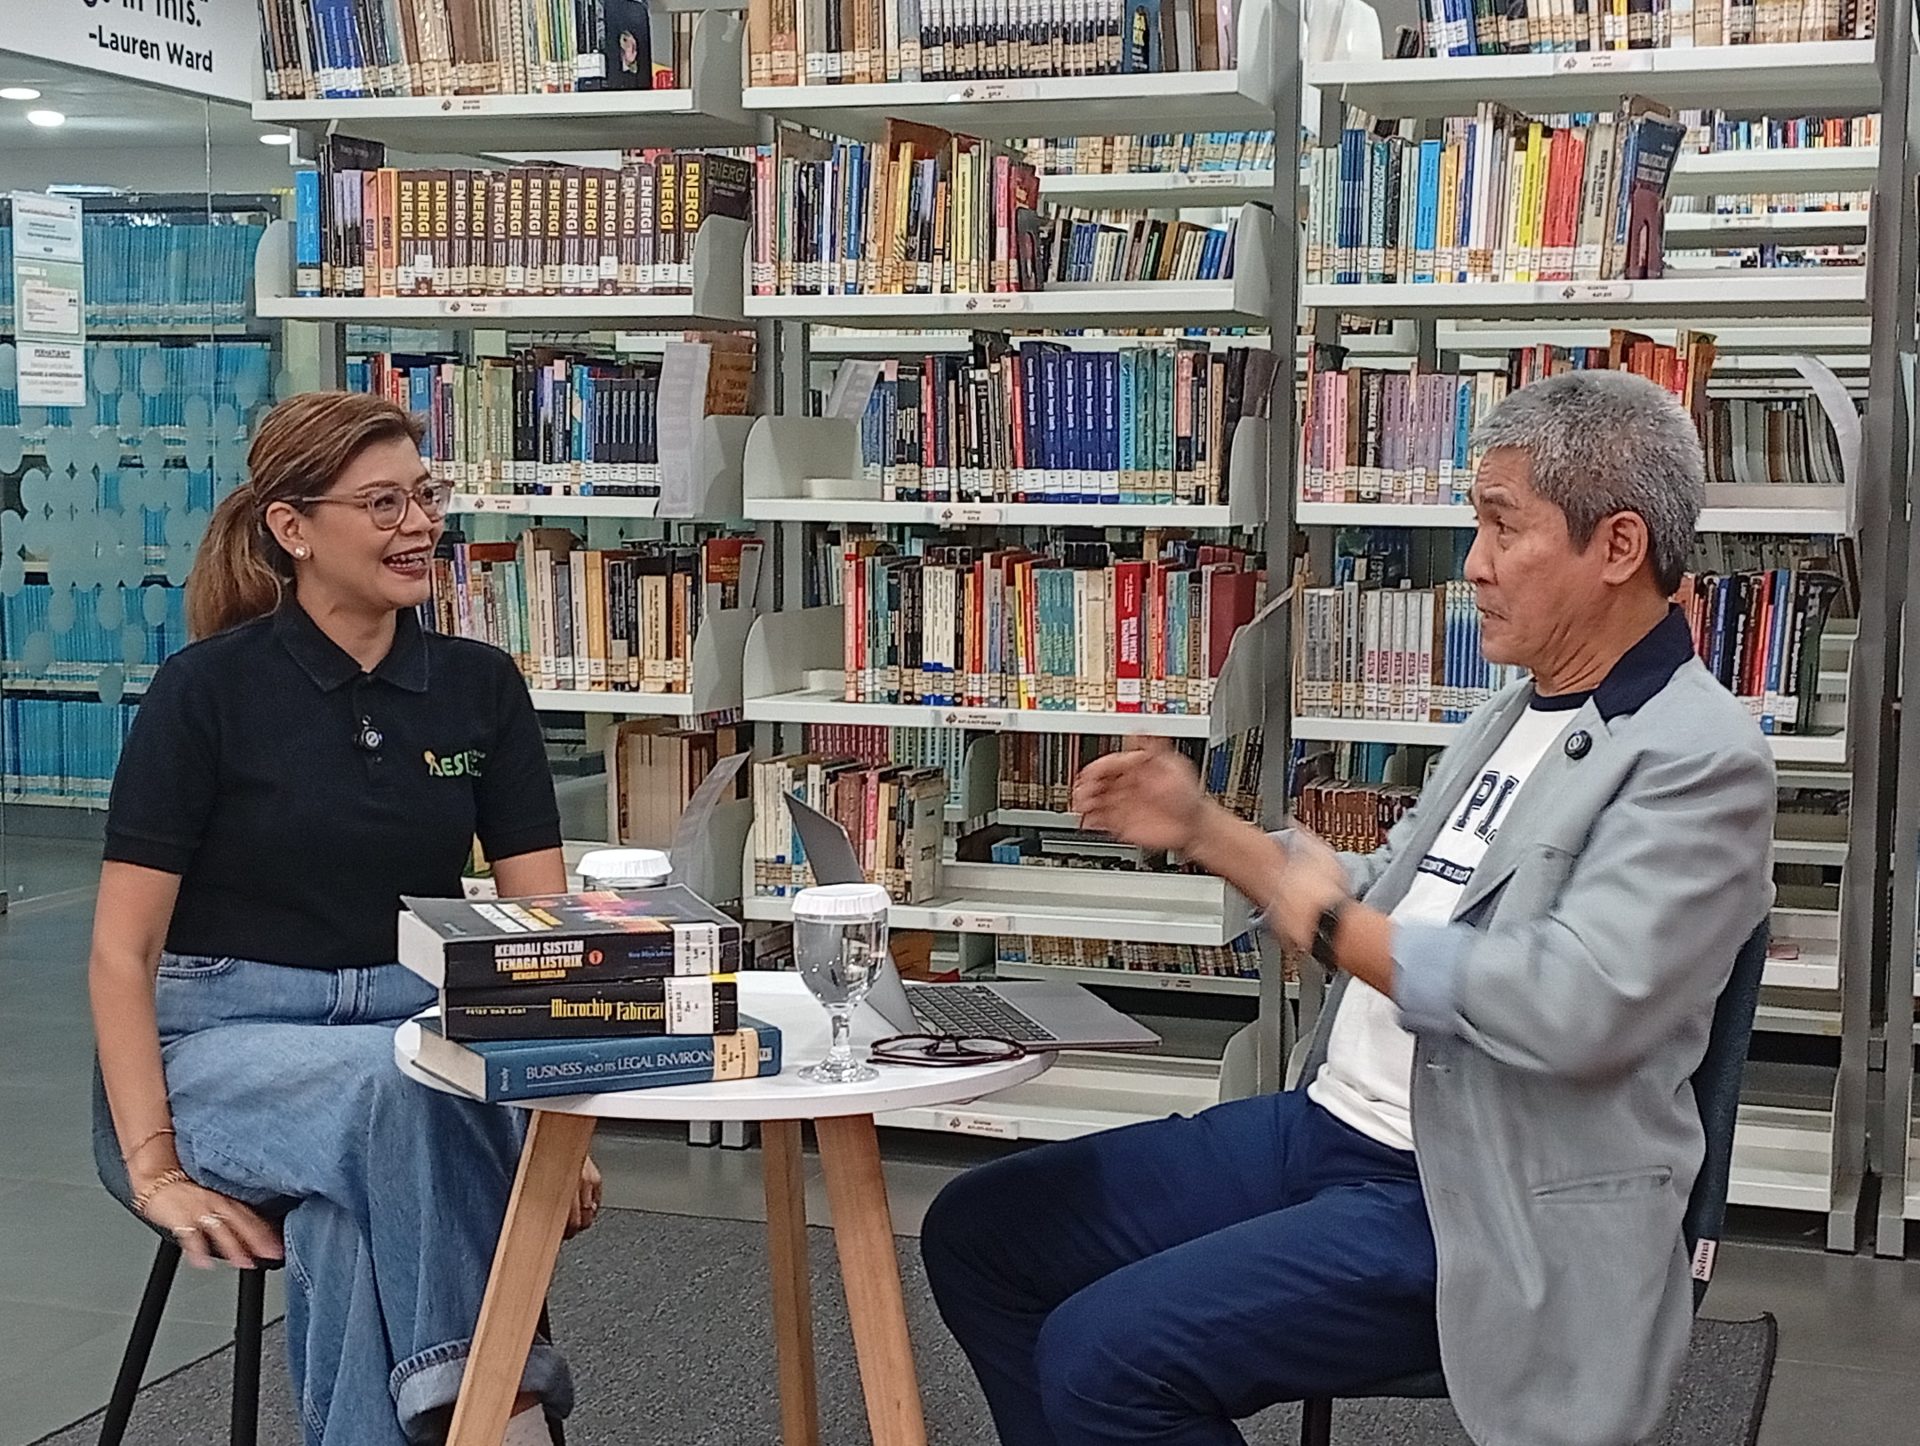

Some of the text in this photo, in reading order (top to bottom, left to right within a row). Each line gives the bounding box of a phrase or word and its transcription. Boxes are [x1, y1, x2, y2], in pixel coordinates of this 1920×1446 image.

[89, 25, 213, 73] -Lauren Ward
[401, 181, 414, 237] ENERGI
[418, 181, 430, 237] ENERGI
[436, 181, 447, 237] ENERGI
[454, 179, 466, 236] ENERGI
[472, 180, 486, 237] ENERGI
[492, 181, 506, 239] ENERGI
[510, 178, 522, 236] ENERGI
[529, 178, 542, 236] ENERGI
[548, 179, 561, 236] ENERGI
[566, 178, 578, 235] ENERGI
[584, 178, 598, 235] ENERGI
[604, 179, 616, 237] ENERGI
[624, 178, 635, 234] ENERGI
[640, 176, 652, 234] ENERGI
[660, 164, 675, 230] ENERGI
[684, 162, 700, 228] ENERGI
[494, 940, 584, 958] KENDALI SISTEM
[495, 954, 583, 972] TENAGA LISTRIK
[551, 998, 612, 1020] Microchip
[526, 1050, 714, 1080] BUSINESS AND ITS LEGAL ENVIRON
